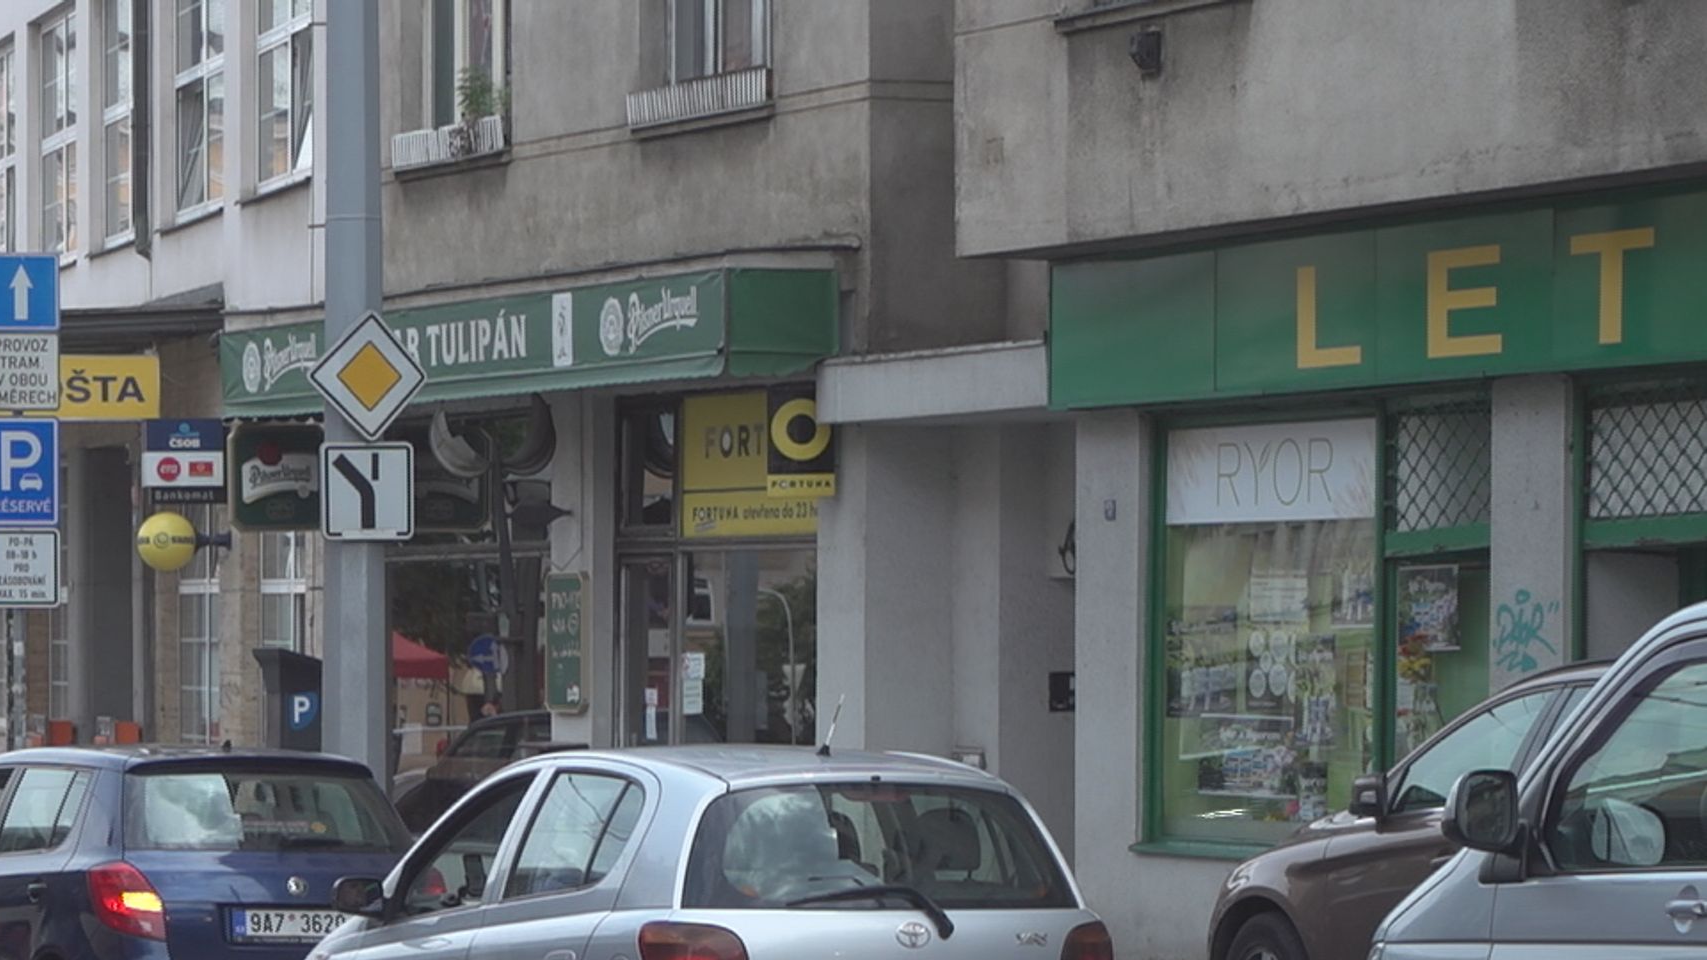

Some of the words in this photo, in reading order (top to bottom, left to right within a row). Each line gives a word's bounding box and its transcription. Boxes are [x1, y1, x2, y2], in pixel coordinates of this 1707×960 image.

[425, 308, 528, 367] TULIPÁN
[9, 373, 48, 386] OBOU
[62, 369, 146, 403] ŠTA
[0, 430, 42, 492] P
[1216, 437, 1334, 507] RYOR
[154, 489, 214, 500] Bankomat
[771, 479, 832, 488] FORTUNA
[692, 505, 739, 521] FORTUNA
[796, 501, 807, 518] 23
[294, 695, 311, 723] P
[250, 913, 285, 933] 9A7
